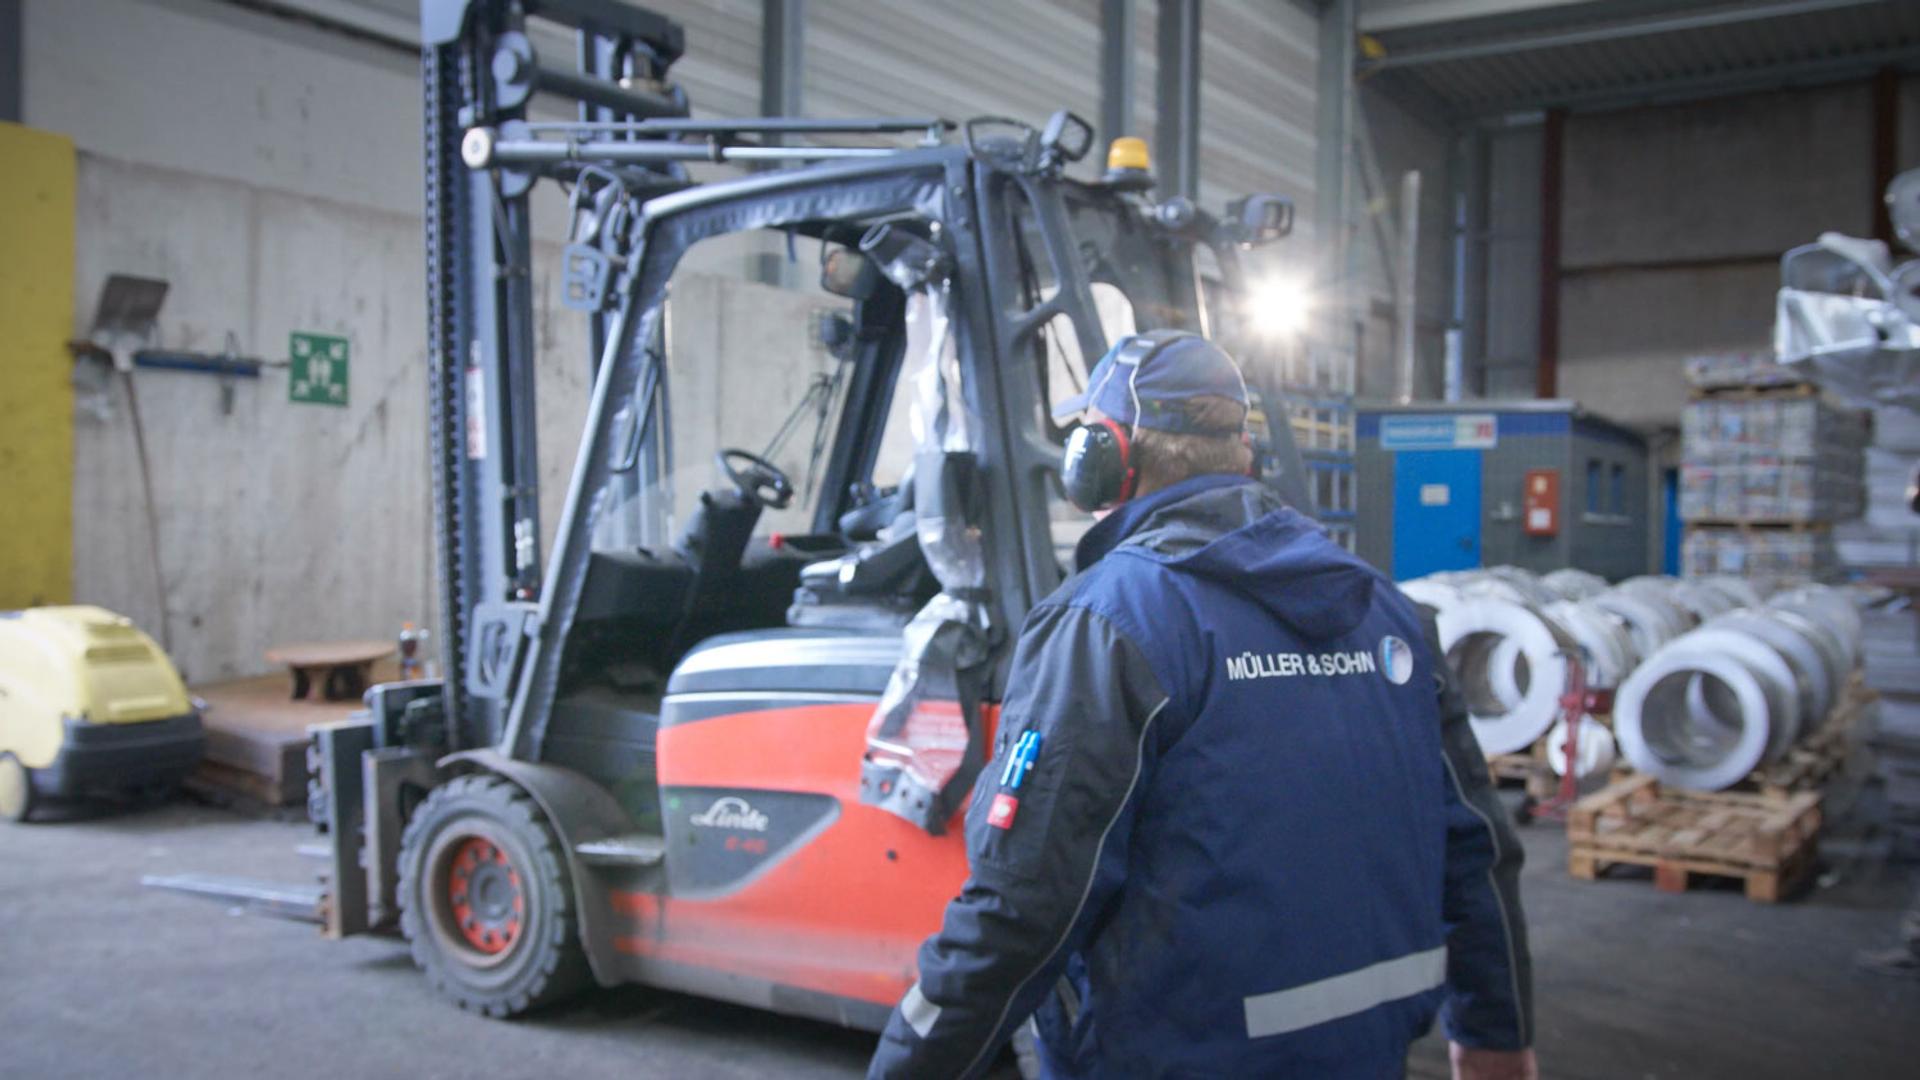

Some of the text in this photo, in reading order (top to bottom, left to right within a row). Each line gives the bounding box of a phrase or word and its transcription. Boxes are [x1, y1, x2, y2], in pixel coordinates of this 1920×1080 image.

[1226, 651, 1375, 680] MÜLLER & SOHN
[690, 797, 769, 832] Linde
